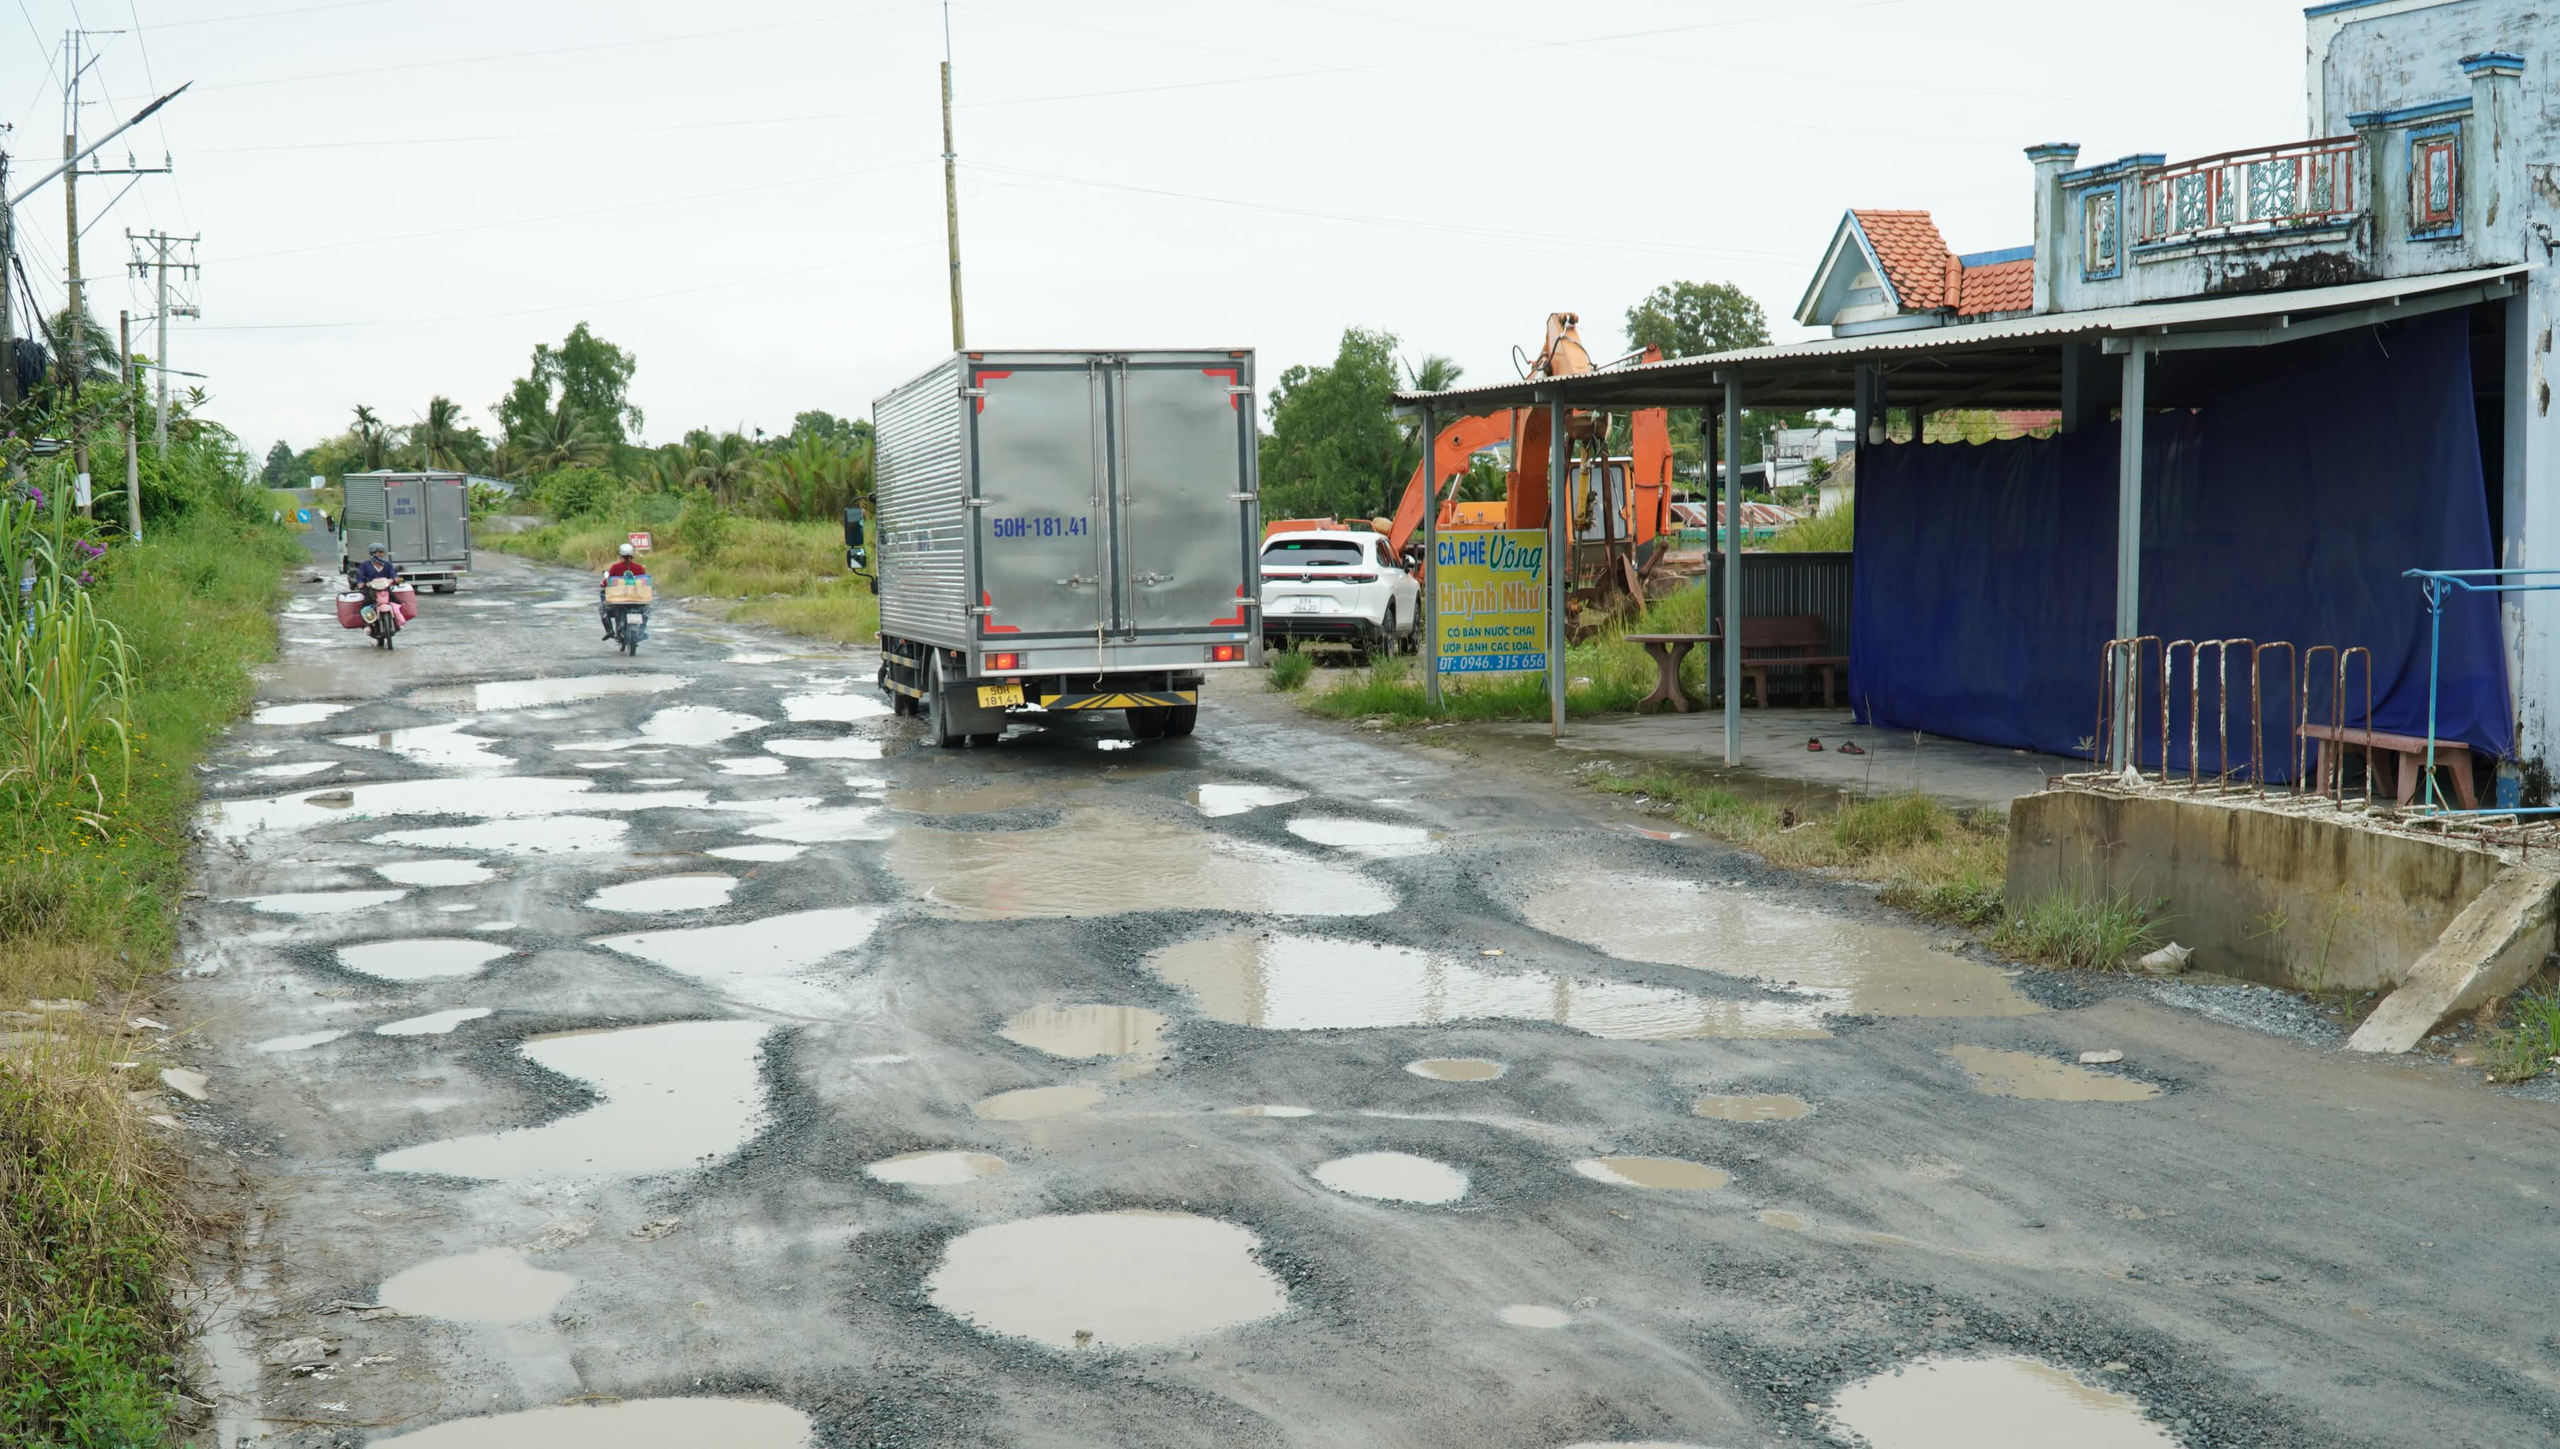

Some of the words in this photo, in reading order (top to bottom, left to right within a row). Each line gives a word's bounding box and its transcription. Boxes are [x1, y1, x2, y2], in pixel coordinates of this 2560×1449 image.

[993, 516, 1087, 538] 50H-181.41
[1438, 535, 1456, 566] CÀ
[1459, 535, 1486, 566] PHÊ
[1488, 534, 1543, 579] Võng
[1438, 580, 1498, 619] Huỳnh
[1502, 582, 1542, 612] Như
[1447, 625, 1460, 637] CÓ
[1462, 625, 1481, 637] BÁN
[1484, 624, 1510, 636] NƯỚC
[1512, 625, 1535, 636] CHAI
[1464, 642, 1488, 654] LẠNH
[1490, 640, 1509, 652] CÁC
[1439, 656, 1456, 670] ĐT:
[1496, 655, 1519, 668] 315
[1522, 654, 1544, 668] 656
[990, 685, 1010, 695] 50H
